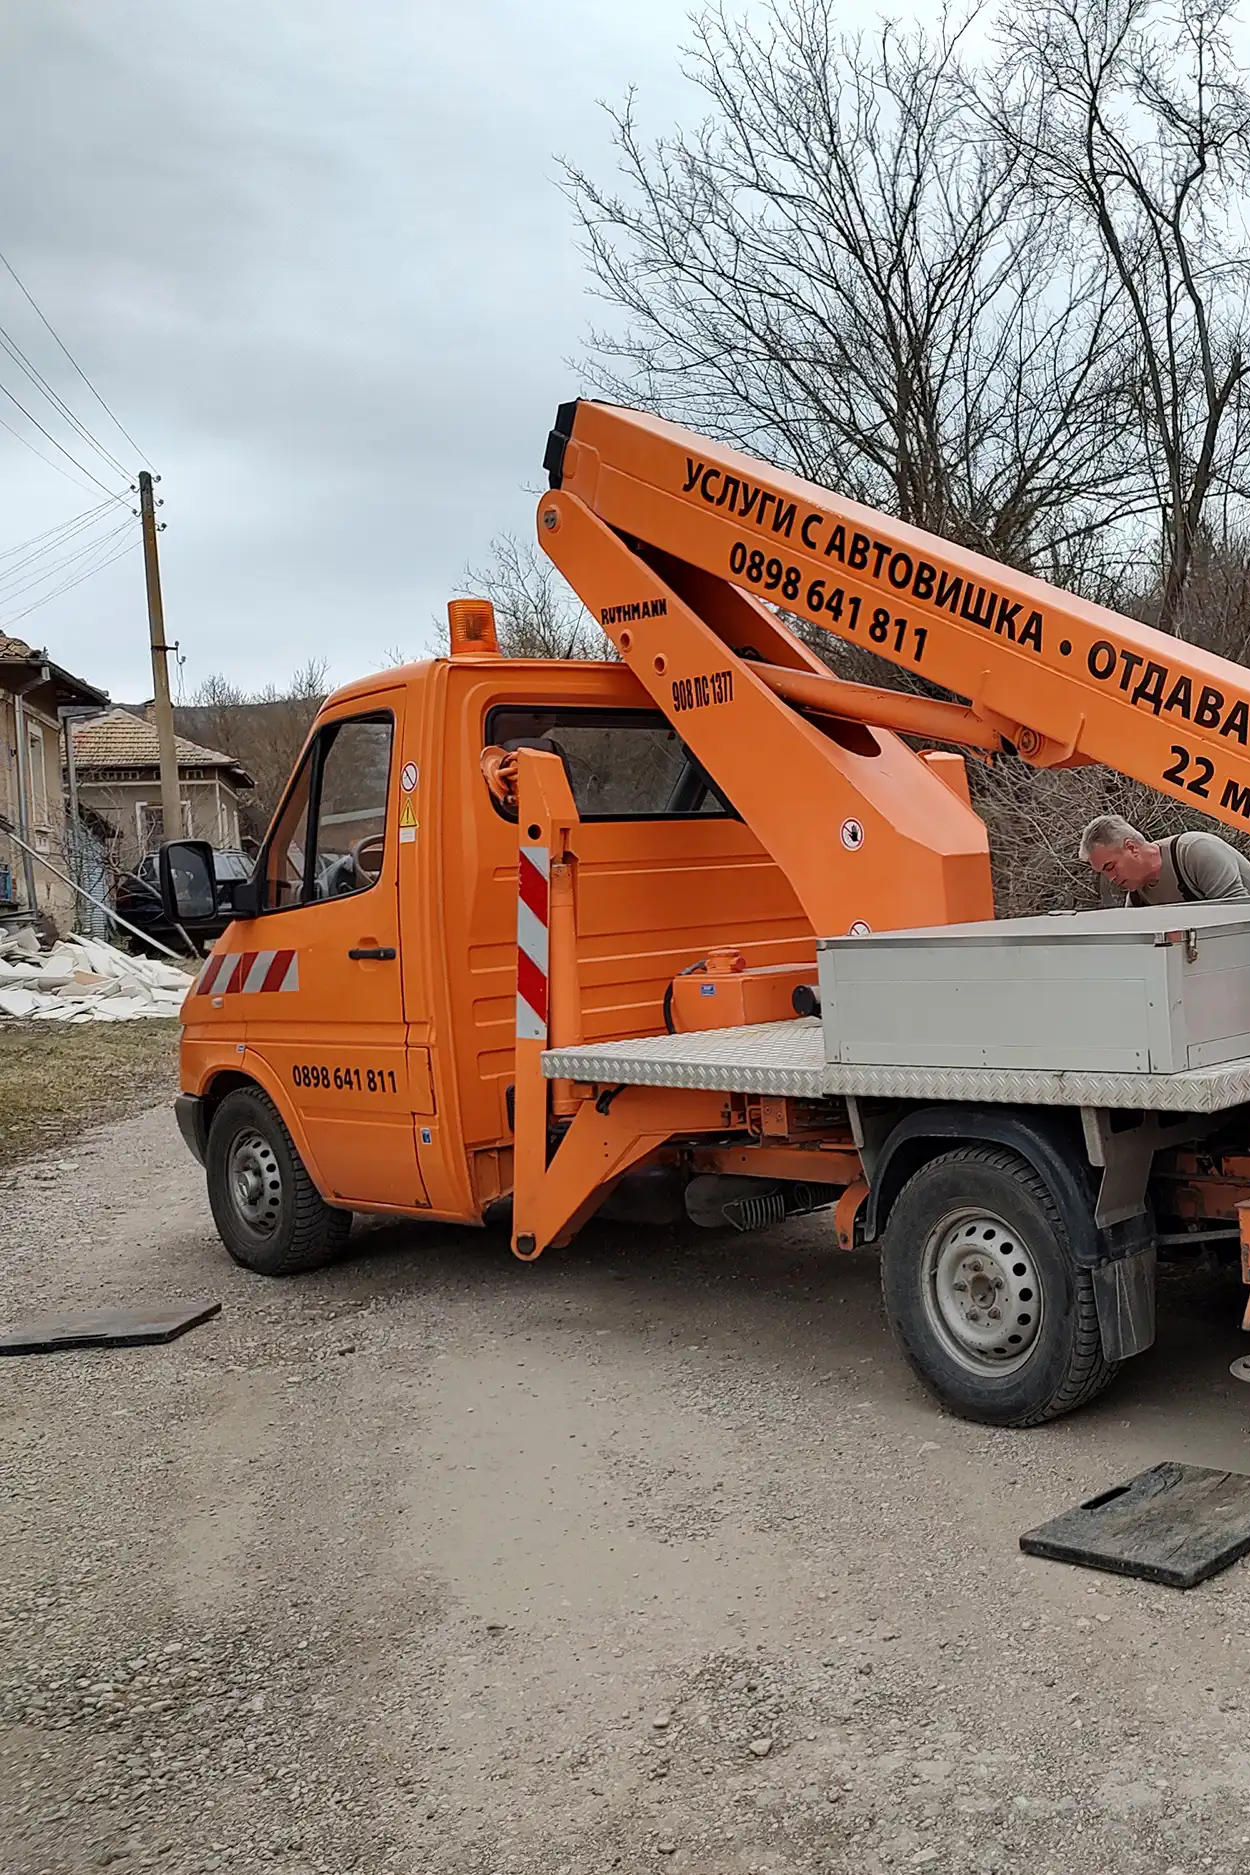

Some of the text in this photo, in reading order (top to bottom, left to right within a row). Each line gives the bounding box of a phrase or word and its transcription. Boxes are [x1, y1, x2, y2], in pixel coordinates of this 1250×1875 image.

[600, 598, 667, 625] RUTHMANN
[682, 458, 798, 537] УСЛУГИ
[825, 523, 1044, 653] АВТОВИШКА
[1087, 640, 1249, 744] ОТДАВА
[729, 541, 929, 662] 0898 641 811
[671, 678, 694, 712] 908
[710, 670, 733, 705] 1377
[1161, 744, 1216, 800] 22
[292, 1064, 397, 1094] 0898 641 811
